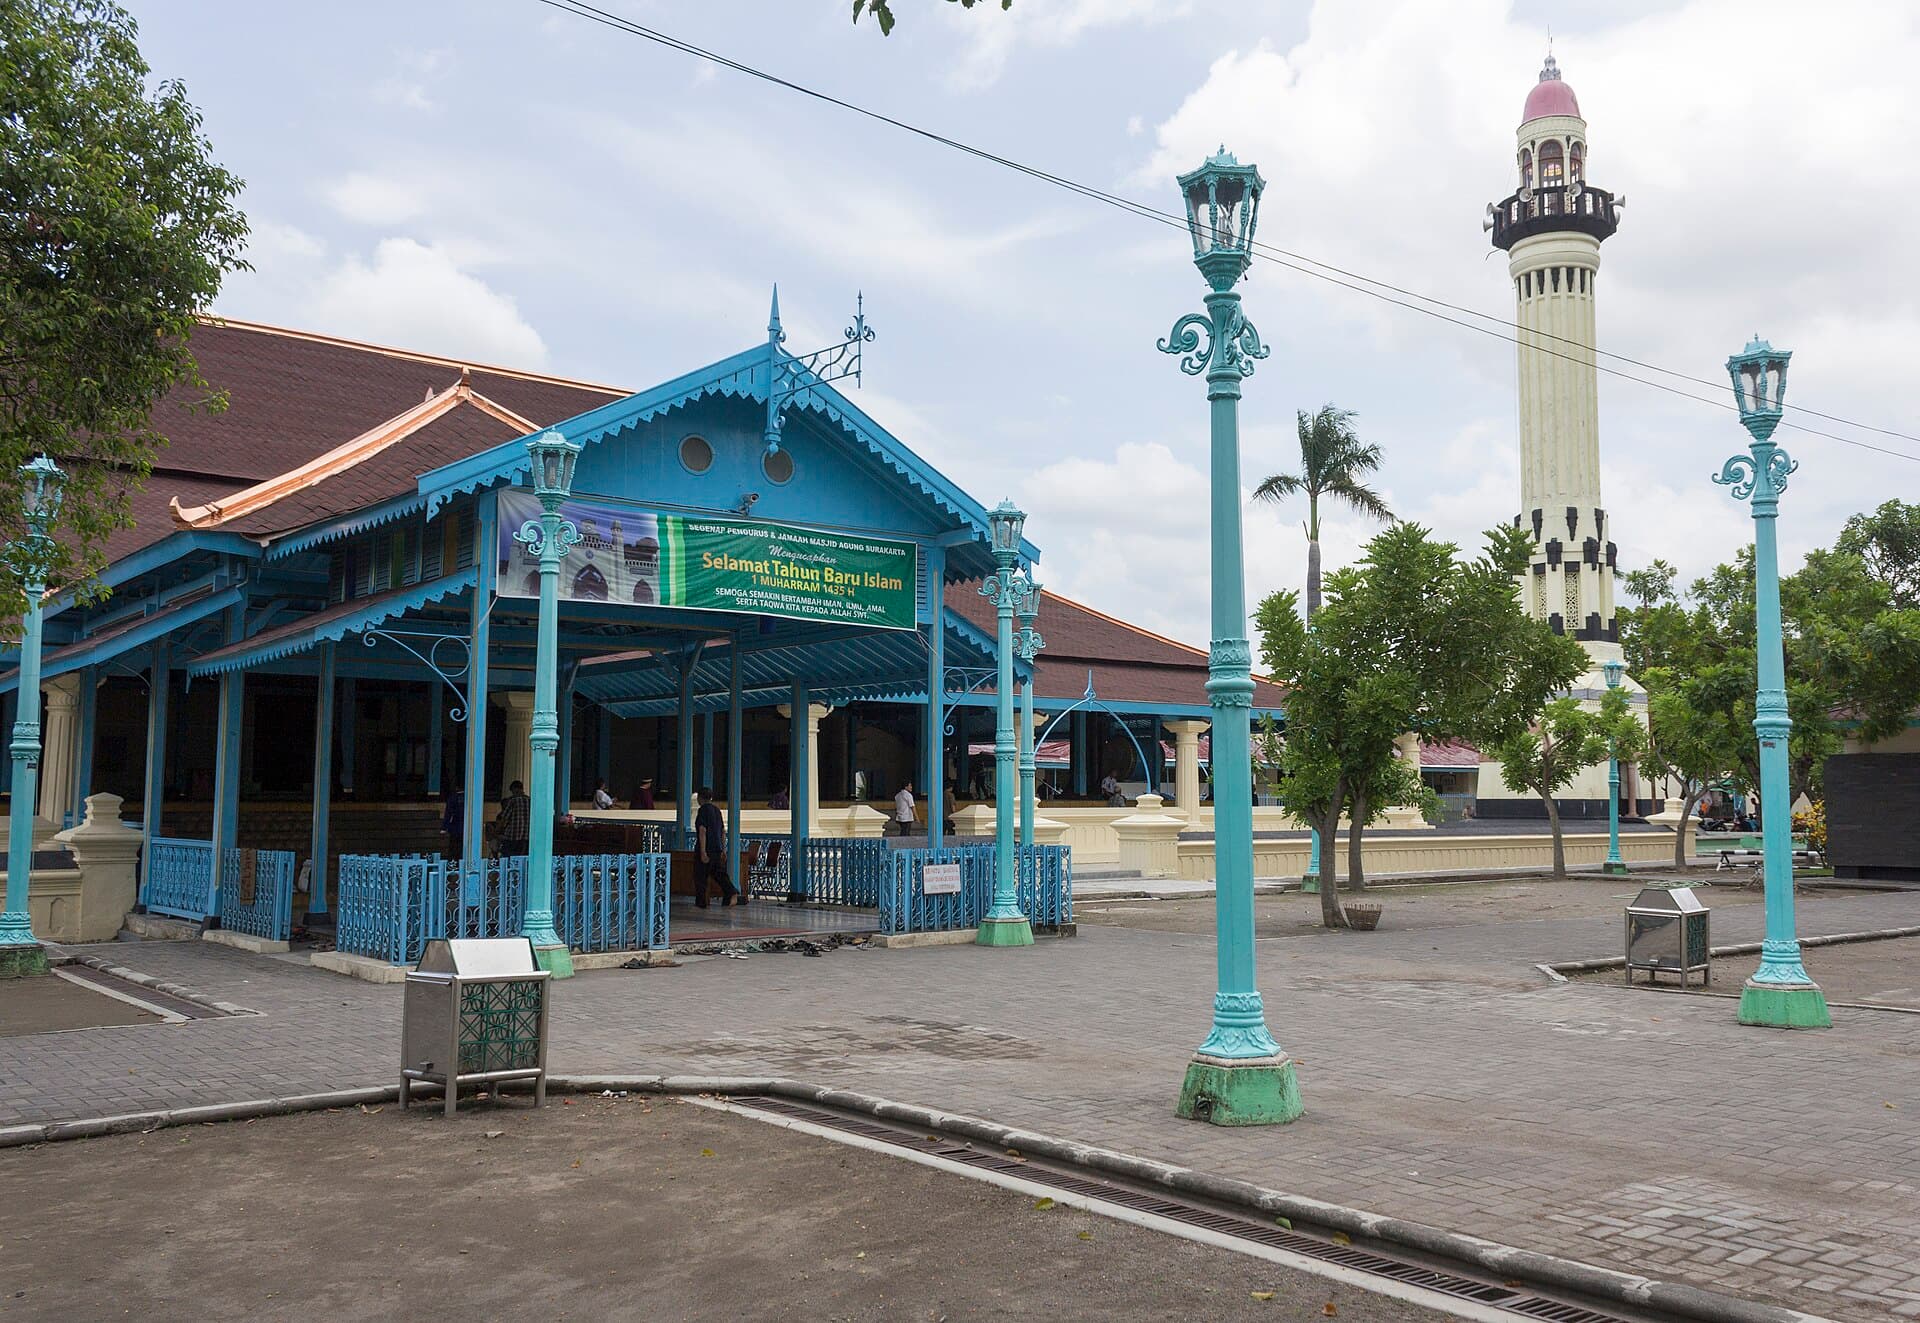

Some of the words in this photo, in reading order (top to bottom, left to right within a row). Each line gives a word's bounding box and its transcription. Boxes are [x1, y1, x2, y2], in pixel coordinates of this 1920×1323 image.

[688, 524, 726, 534] SEGENAP
[727, 527, 769, 538] PENGURUS
[777, 533, 809, 544] JAMAAH
[809, 539, 837, 547] MASJID
[838, 542, 864, 551] AGUNG
[865, 545, 906, 556] SURAKARTA
[768, 545, 837, 563] Mengucapkan
[703, 552, 769, 574] Selamat
[772, 560, 819, 580] Tahun
[824, 567, 860, 585] Baru
[864, 572, 902, 590] Islam
[752, 574, 757, 584] 1
[760, 576, 820, 593] MUHARRAM
[823, 584, 845, 596] 1435
[847, 587, 855, 597] H
[715, 588, 747, 597] SEMOGA
[750, 590, 780, 600] SEMAKIN
[781, 594, 822, 606] BERTAMBAH
[866, 605, 886, 614] AMAL
[735, 597, 758, 607] SERTA
[759, 599, 785, 610] TAQWA
[785, 603, 801, 612] KITA
[801, 604, 829, 616] KEPADA
[830, 609, 853, 618] ALLAH
